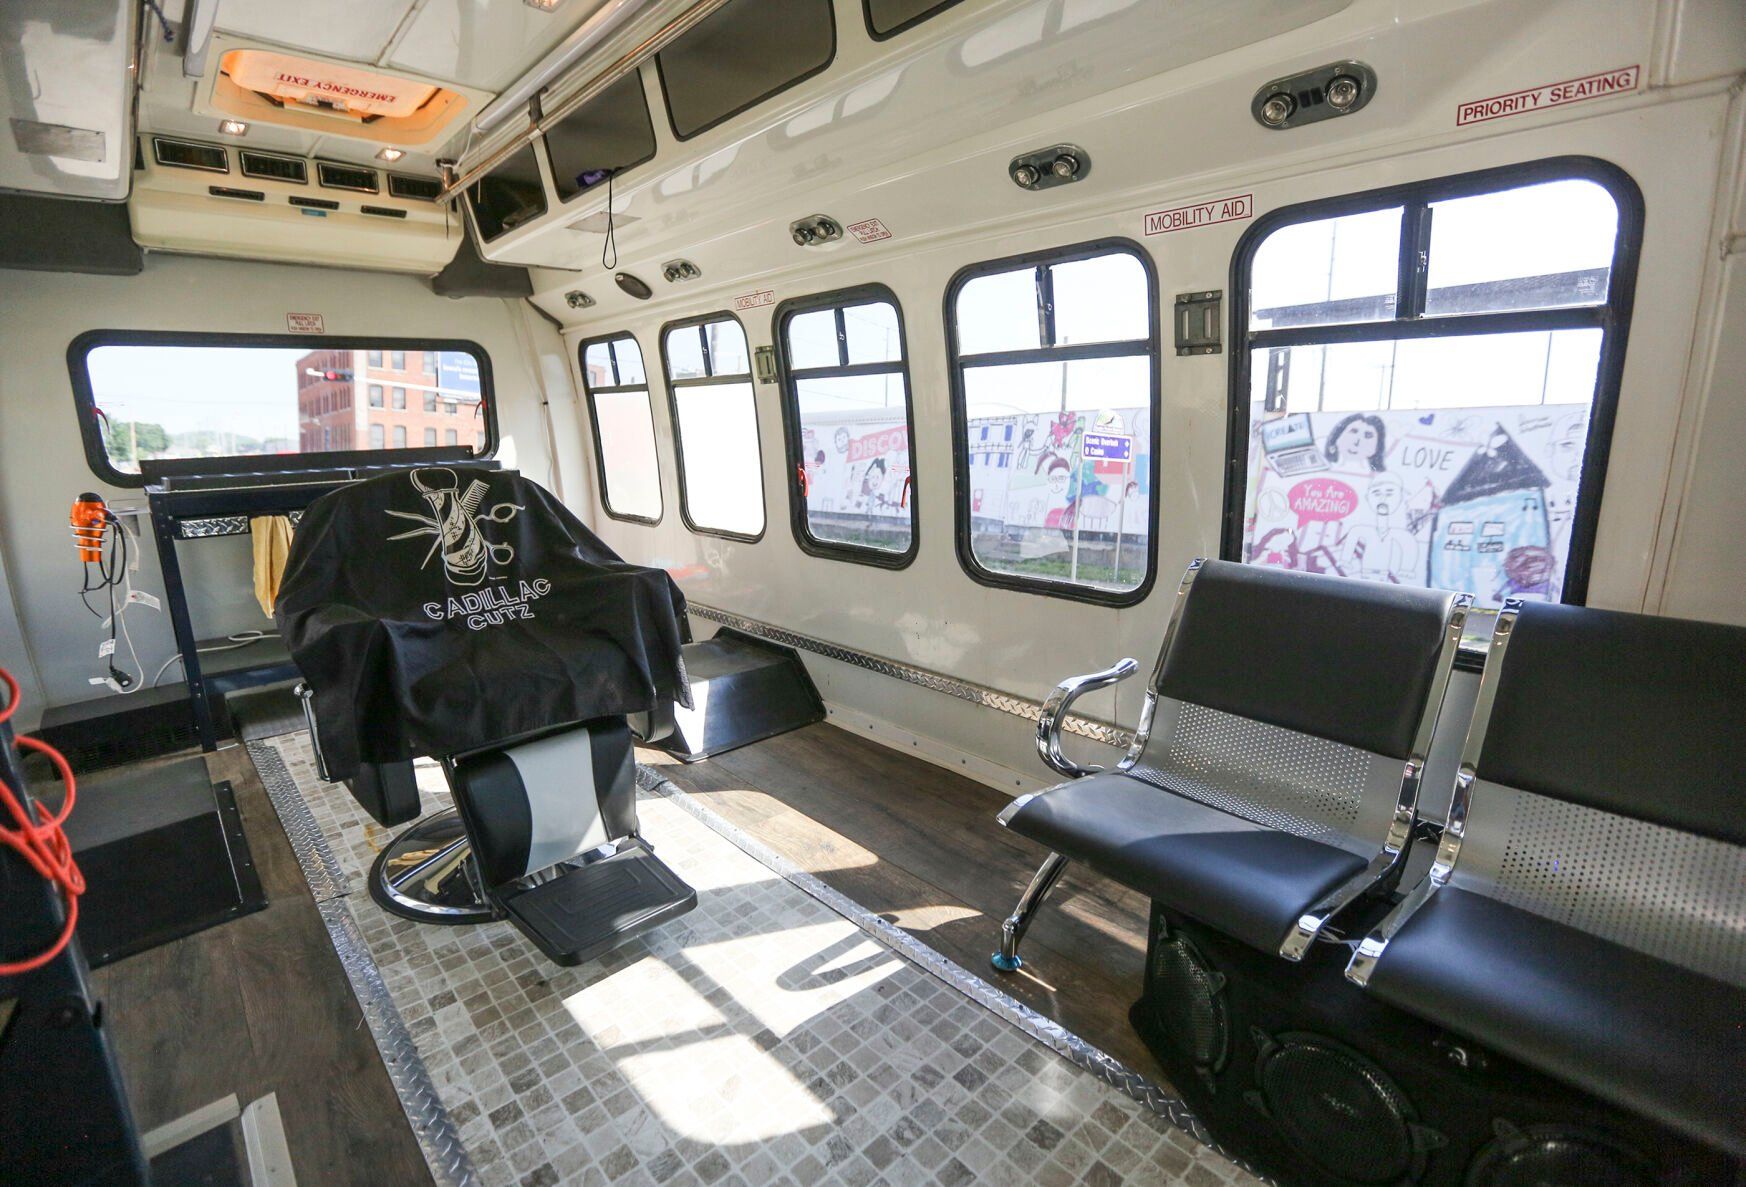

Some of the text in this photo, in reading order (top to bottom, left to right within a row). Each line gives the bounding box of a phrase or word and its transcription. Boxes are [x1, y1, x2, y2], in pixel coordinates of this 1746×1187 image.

[279, 73, 397, 103] EMERGENCY EXIT
[1463, 72, 1632, 121] PRIORITY SEATING
[1150, 200, 1245, 231] MOBILITY AID
[736, 293, 773, 309] MOBILITY AID
[1402, 446, 1454, 470] LOVE
[1294, 497, 1351, 515] AMAZING!
[1304, 484, 1345, 500] You Are
[423, 578, 551, 620] CADILLAC
[467, 603, 535, 631] CUTZ
